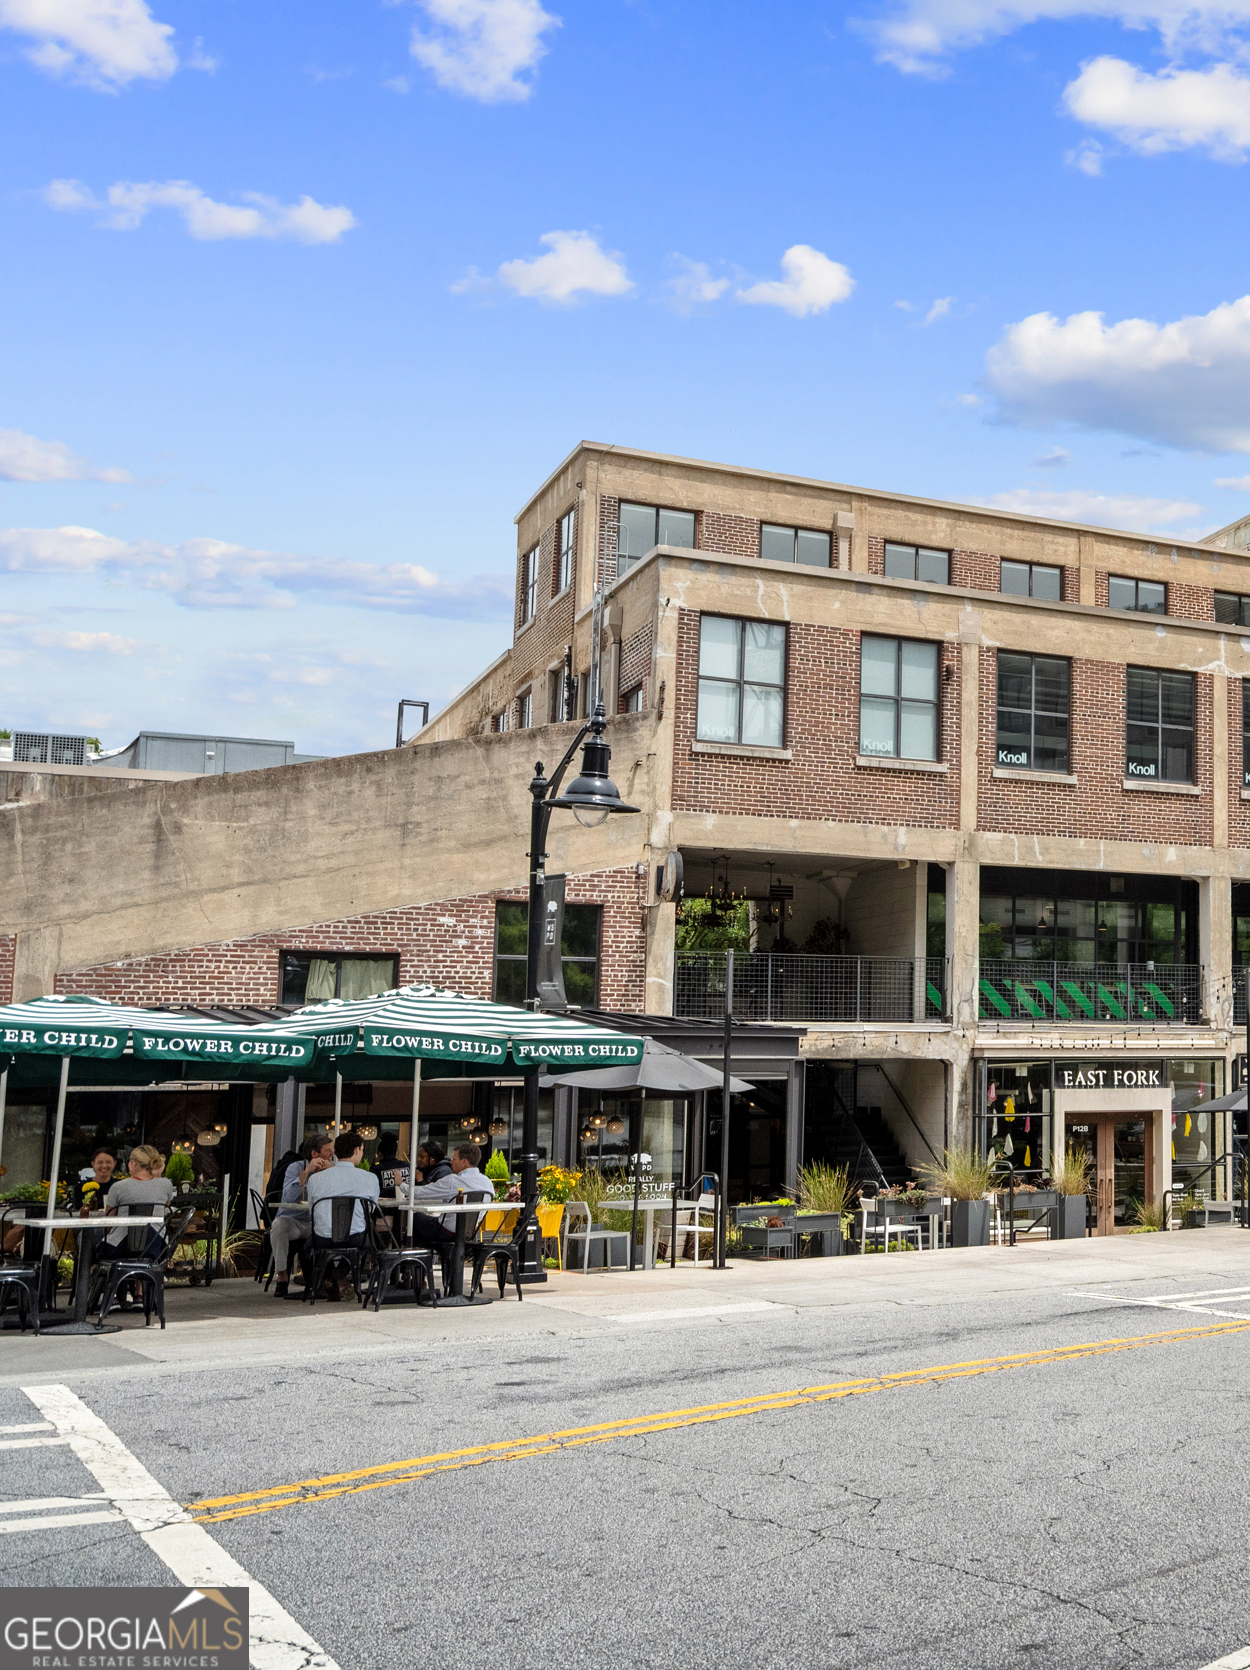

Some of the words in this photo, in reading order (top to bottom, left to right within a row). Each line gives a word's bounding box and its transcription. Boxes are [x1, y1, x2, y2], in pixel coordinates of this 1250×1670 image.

[702, 724, 735, 738] Knoll
[863, 738, 894, 752] Knoll
[998, 750, 1027, 764] Knoll
[1128, 762, 1155, 776] Knoll
[0, 1029, 37, 1043] ER
[43, 1031, 118, 1049] CHILD
[317, 1034, 354, 1048] CHILD
[371, 1034, 445, 1050] FLOWER
[449, 1039, 502, 1056] CHILD
[143, 1037, 234, 1053] FLOWER
[239, 1041, 305, 1057] CHILD
[519, 1045, 585, 1057] FLOWER
[588, 1045, 638, 1057] CHILD
[1064, 1070, 1107, 1086] EAST
[1113, 1070, 1160, 1086] FORK
[384, 1169, 410, 1179] ATLTA
[384, 1176, 411, 1187] POCE
[642, 1182, 675, 1193] STUFF
